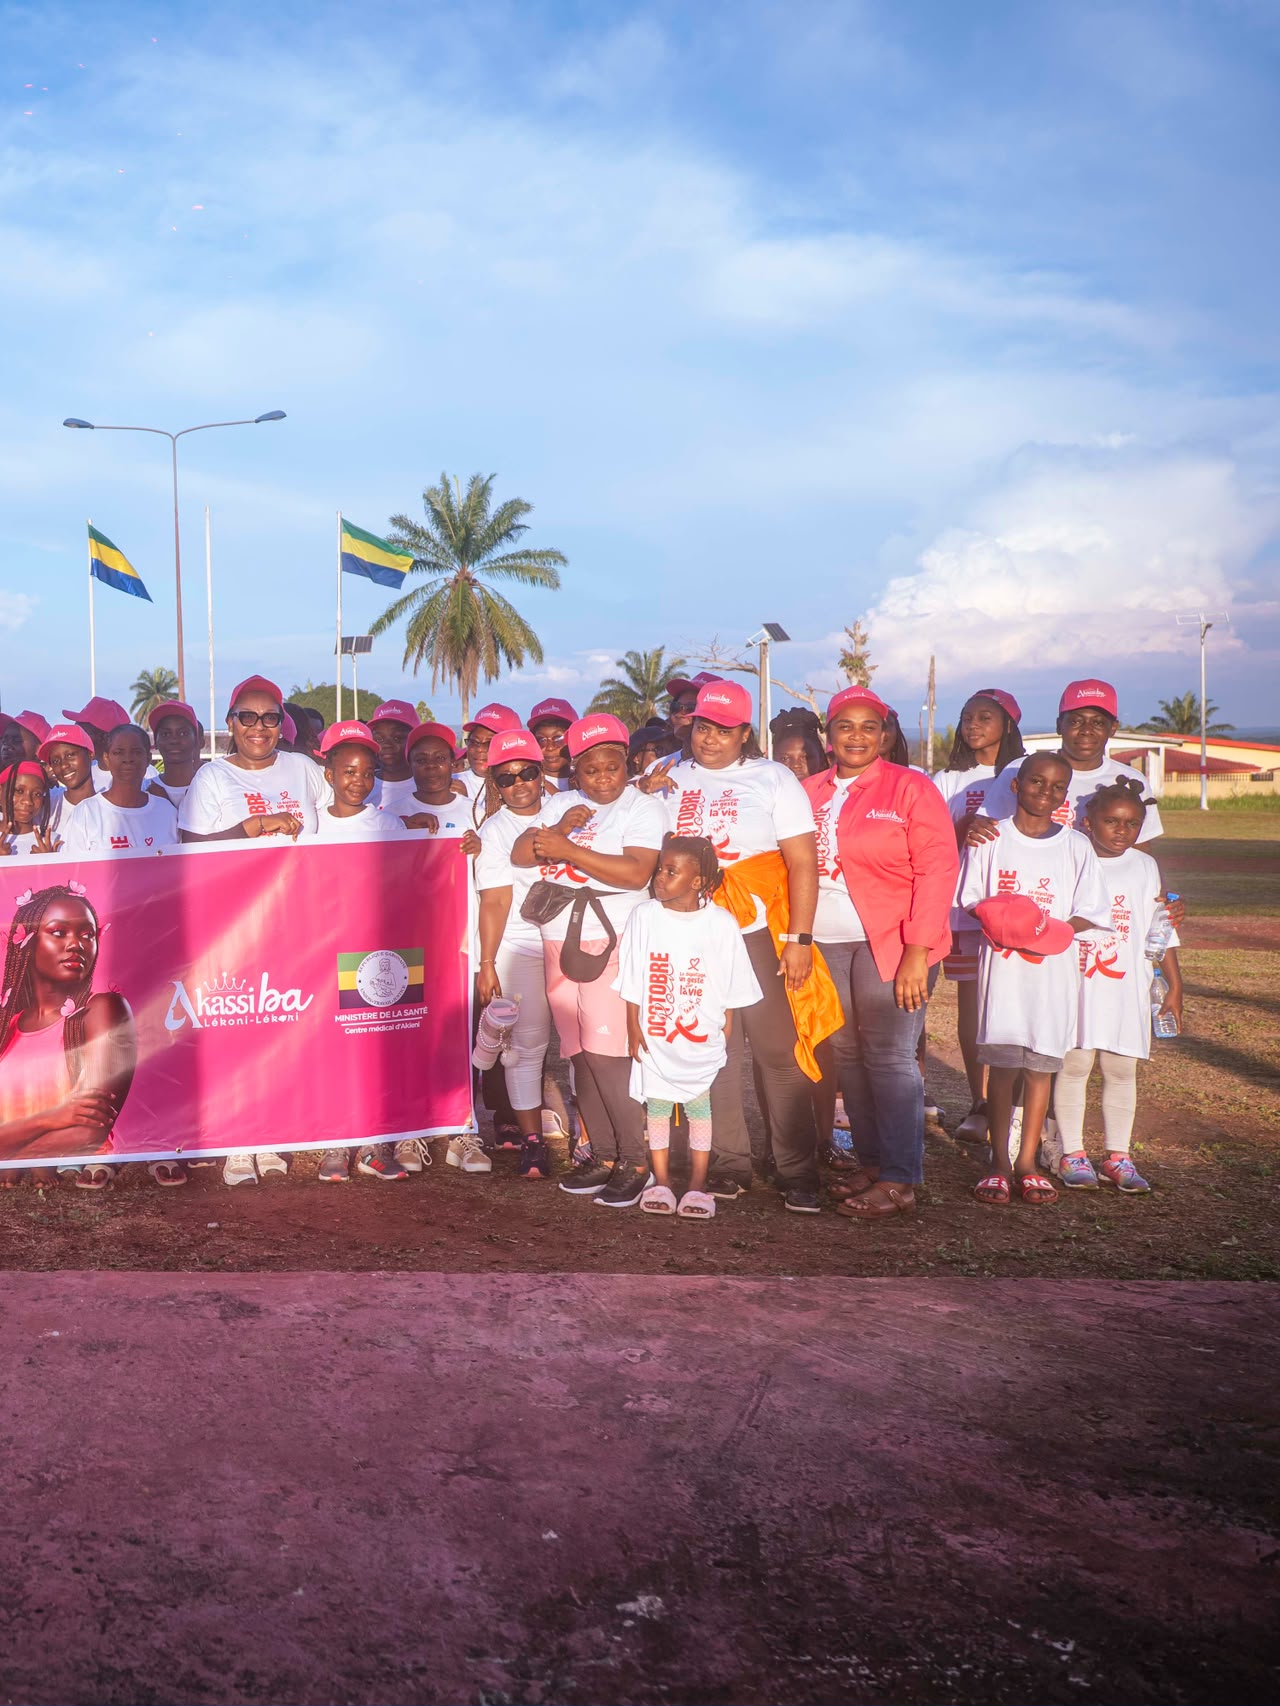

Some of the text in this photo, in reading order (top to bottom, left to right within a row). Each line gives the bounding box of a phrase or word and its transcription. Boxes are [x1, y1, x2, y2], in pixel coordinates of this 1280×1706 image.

[709, 807, 738, 817] la vie
[679, 985, 703, 997] la vie
[164, 971, 314, 1031] Akassiba
[335, 1010, 378, 1023] MINISTÈRE
[380, 1011, 391, 1019] DE
[404, 1006, 428, 1016] SANTÉ
[345, 1027, 368, 1035] Centre
[369, 1024, 394, 1033] médical
[978, 1178, 1009, 1191] YES
[1023, 1178, 1054, 1190] NO
